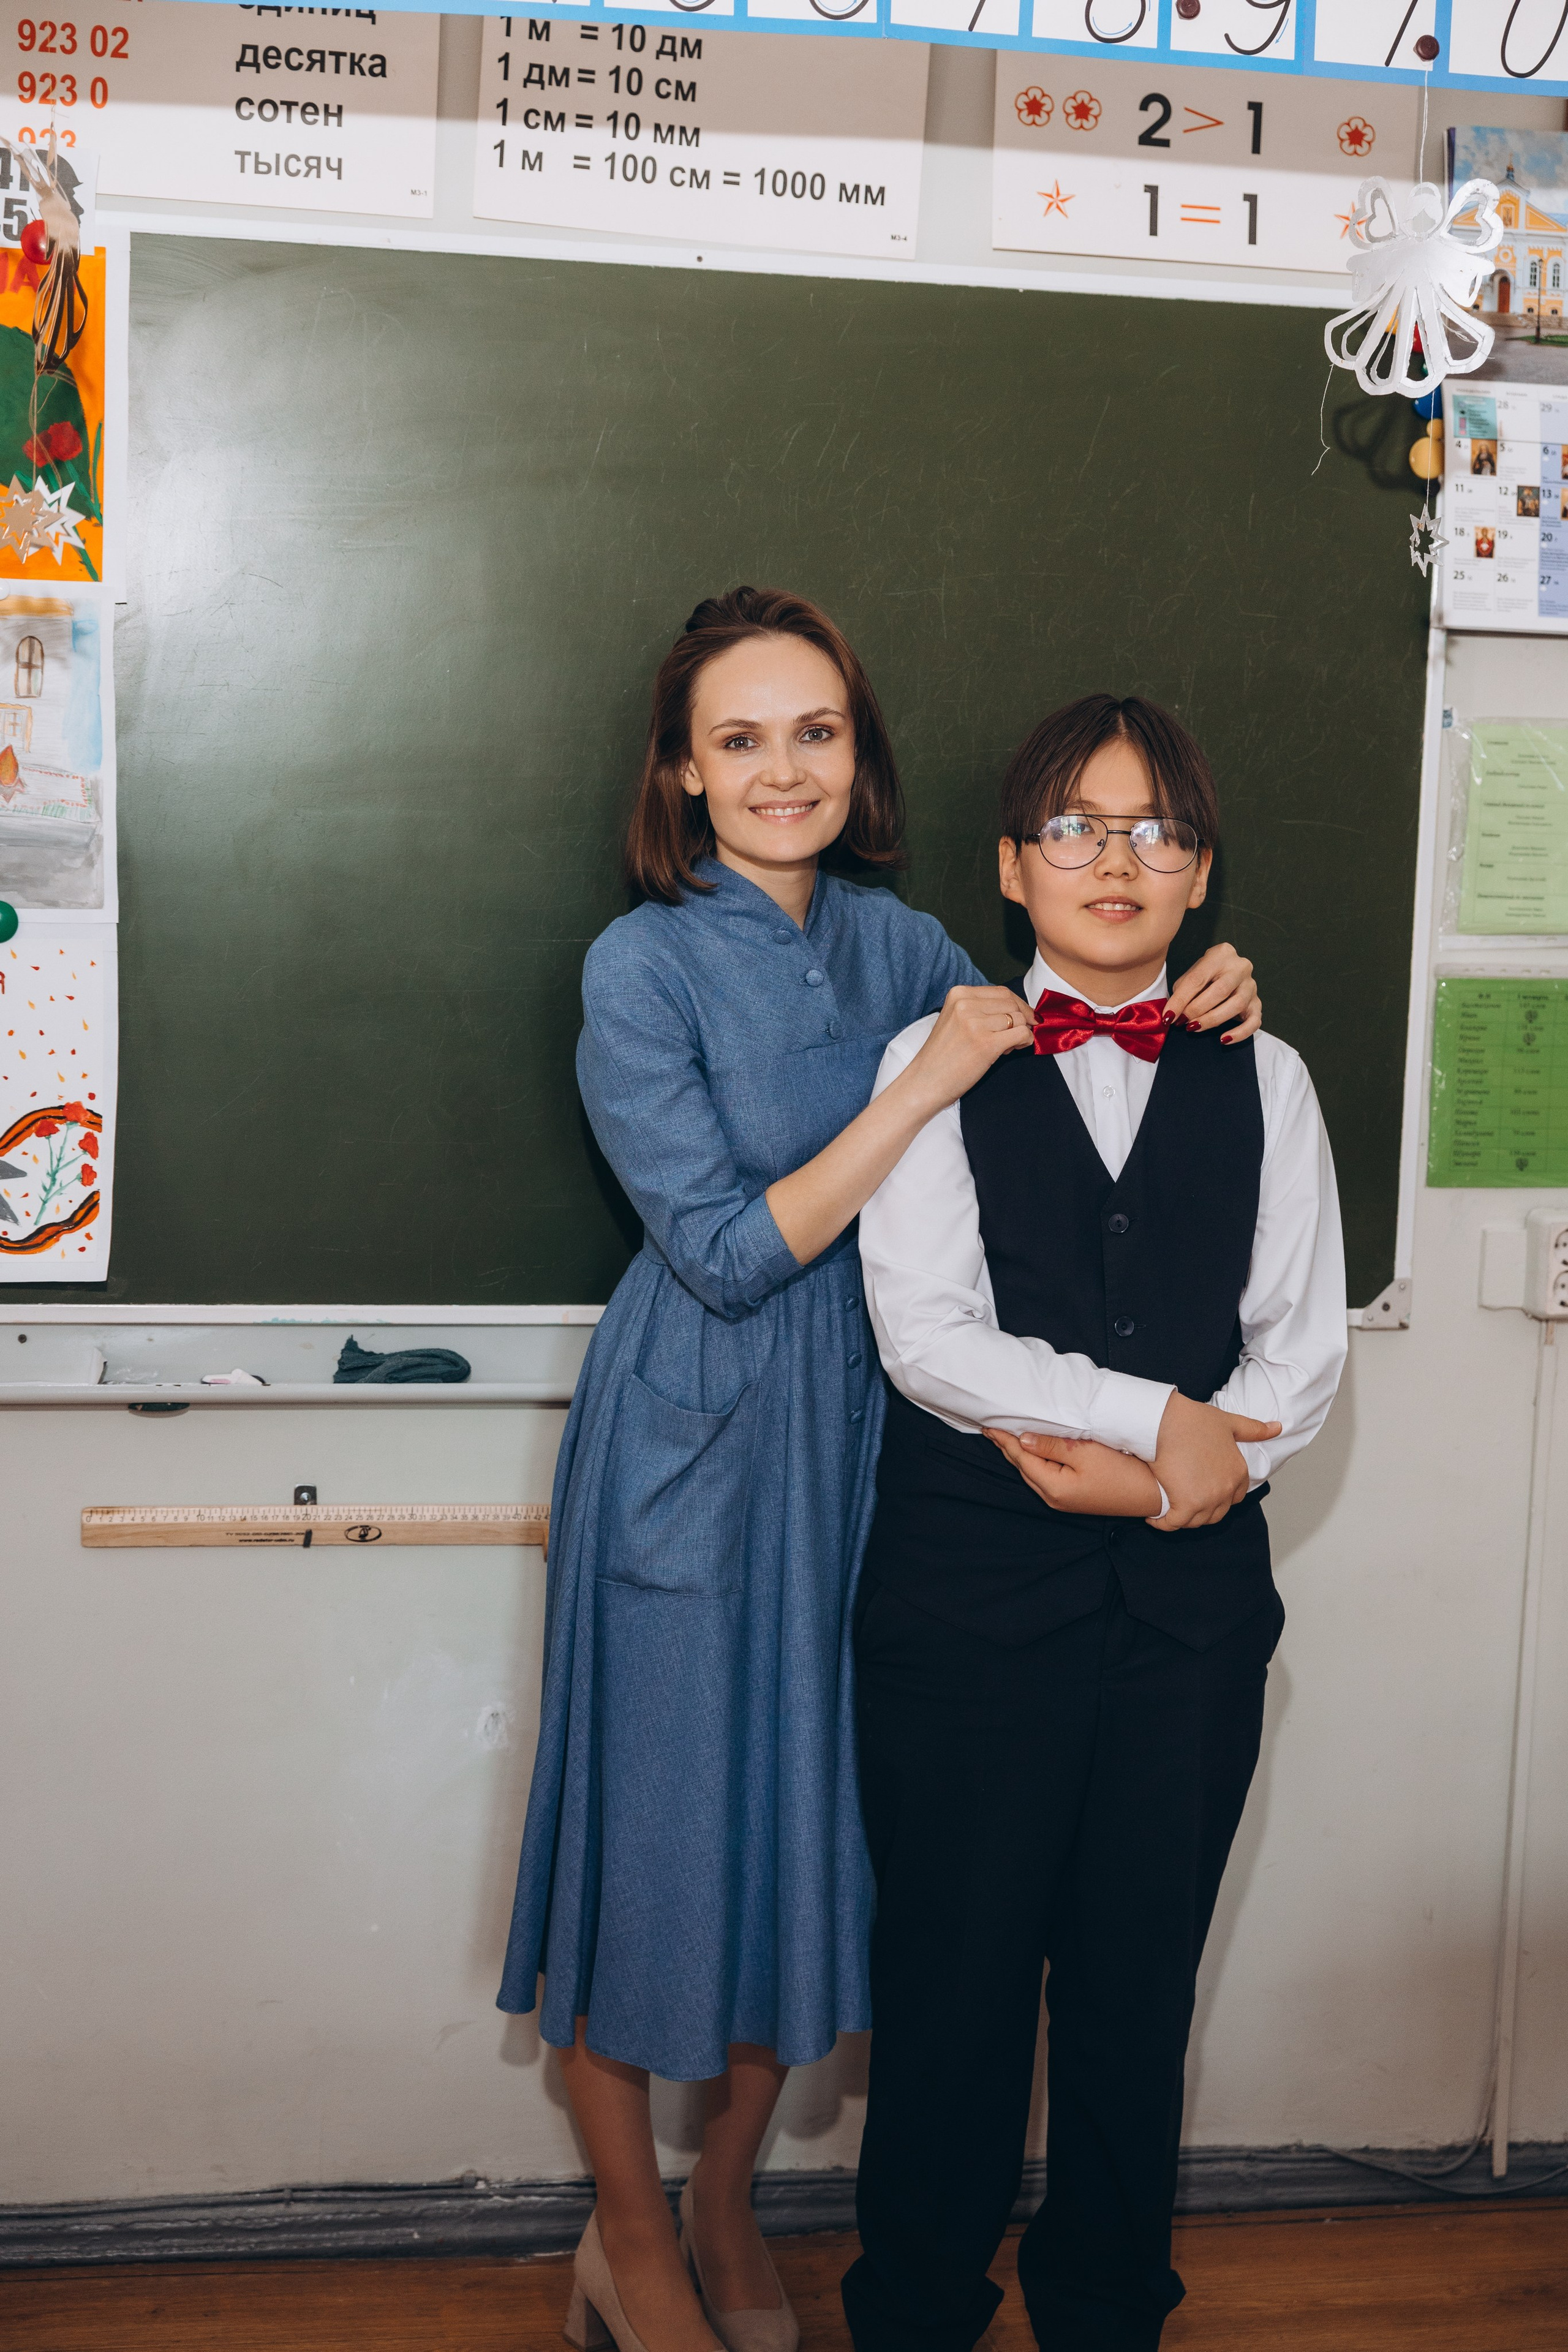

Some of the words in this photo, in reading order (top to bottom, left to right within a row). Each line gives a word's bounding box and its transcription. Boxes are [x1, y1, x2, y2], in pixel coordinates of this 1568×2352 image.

[18, 19, 77, 55] 923
[90, 25, 129, 59] 02
[235, 43, 387, 78] десятка
[500, 17, 511, 37] 1
[529, 19, 551, 42] м
[612, 23, 646, 53] 10
[655, 34, 703, 62] дм
[18, 71, 77, 107] 923
[90, 77, 108, 108] 0
[498, 52, 510, 81] 1
[522, 62, 570, 91] дм
[609, 65, 643, 96] 10
[655, 78, 696, 102] см
[235, 97, 344, 127] сотен
[496, 97, 508, 126] 1
[524, 108, 565, 132] см
[606, 110, 641, 141] 10
[654, 123, 701, 148] мм
[1138, 92, 1172, 148] 2
[1247, 101, 1263, 154] 1
[235, 151, 342, 180] тысяч
[494, 139, 505, 168] 1
[521, 149, 543, 172] м
[605, 151, 657, 184] 100
[669, 166, 710, 190] см
[754, 167, 826, 200] 1000
[839, 182, 885, 206] мм
[1144, 184, 1159, 236] 1
[1243, 193, 1257, 245] 1
